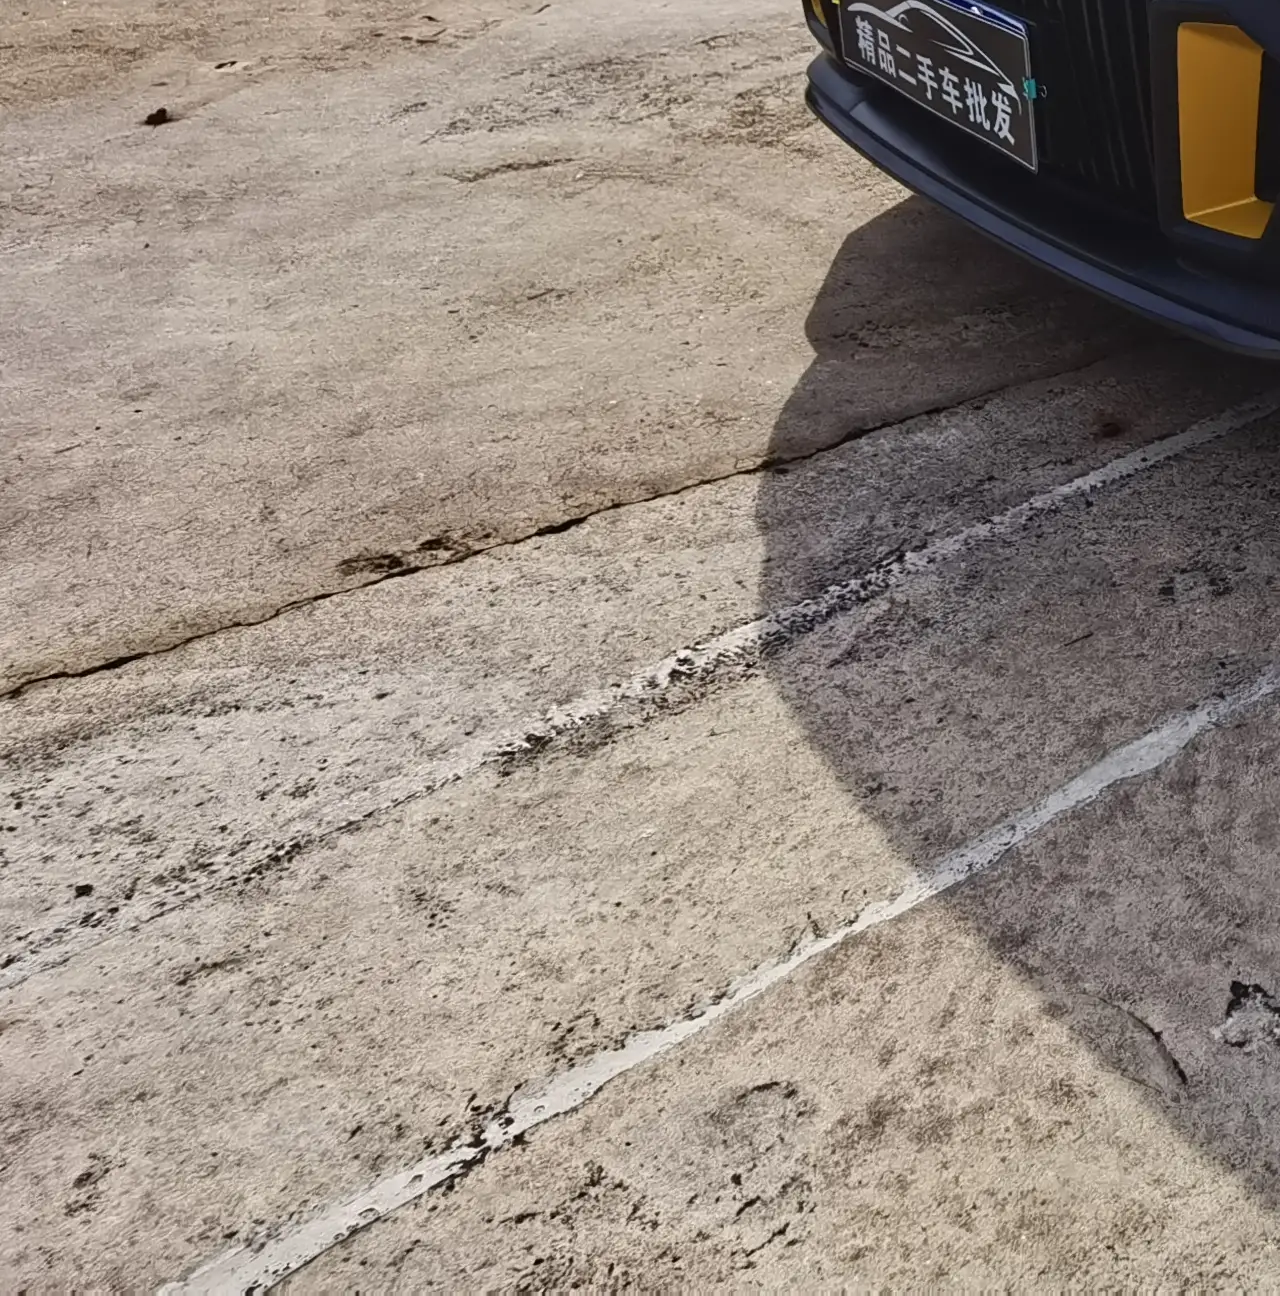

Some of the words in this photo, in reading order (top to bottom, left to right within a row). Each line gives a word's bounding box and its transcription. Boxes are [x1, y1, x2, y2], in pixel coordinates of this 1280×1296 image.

[855, 15, 1015, 145] 精品二手车批发
